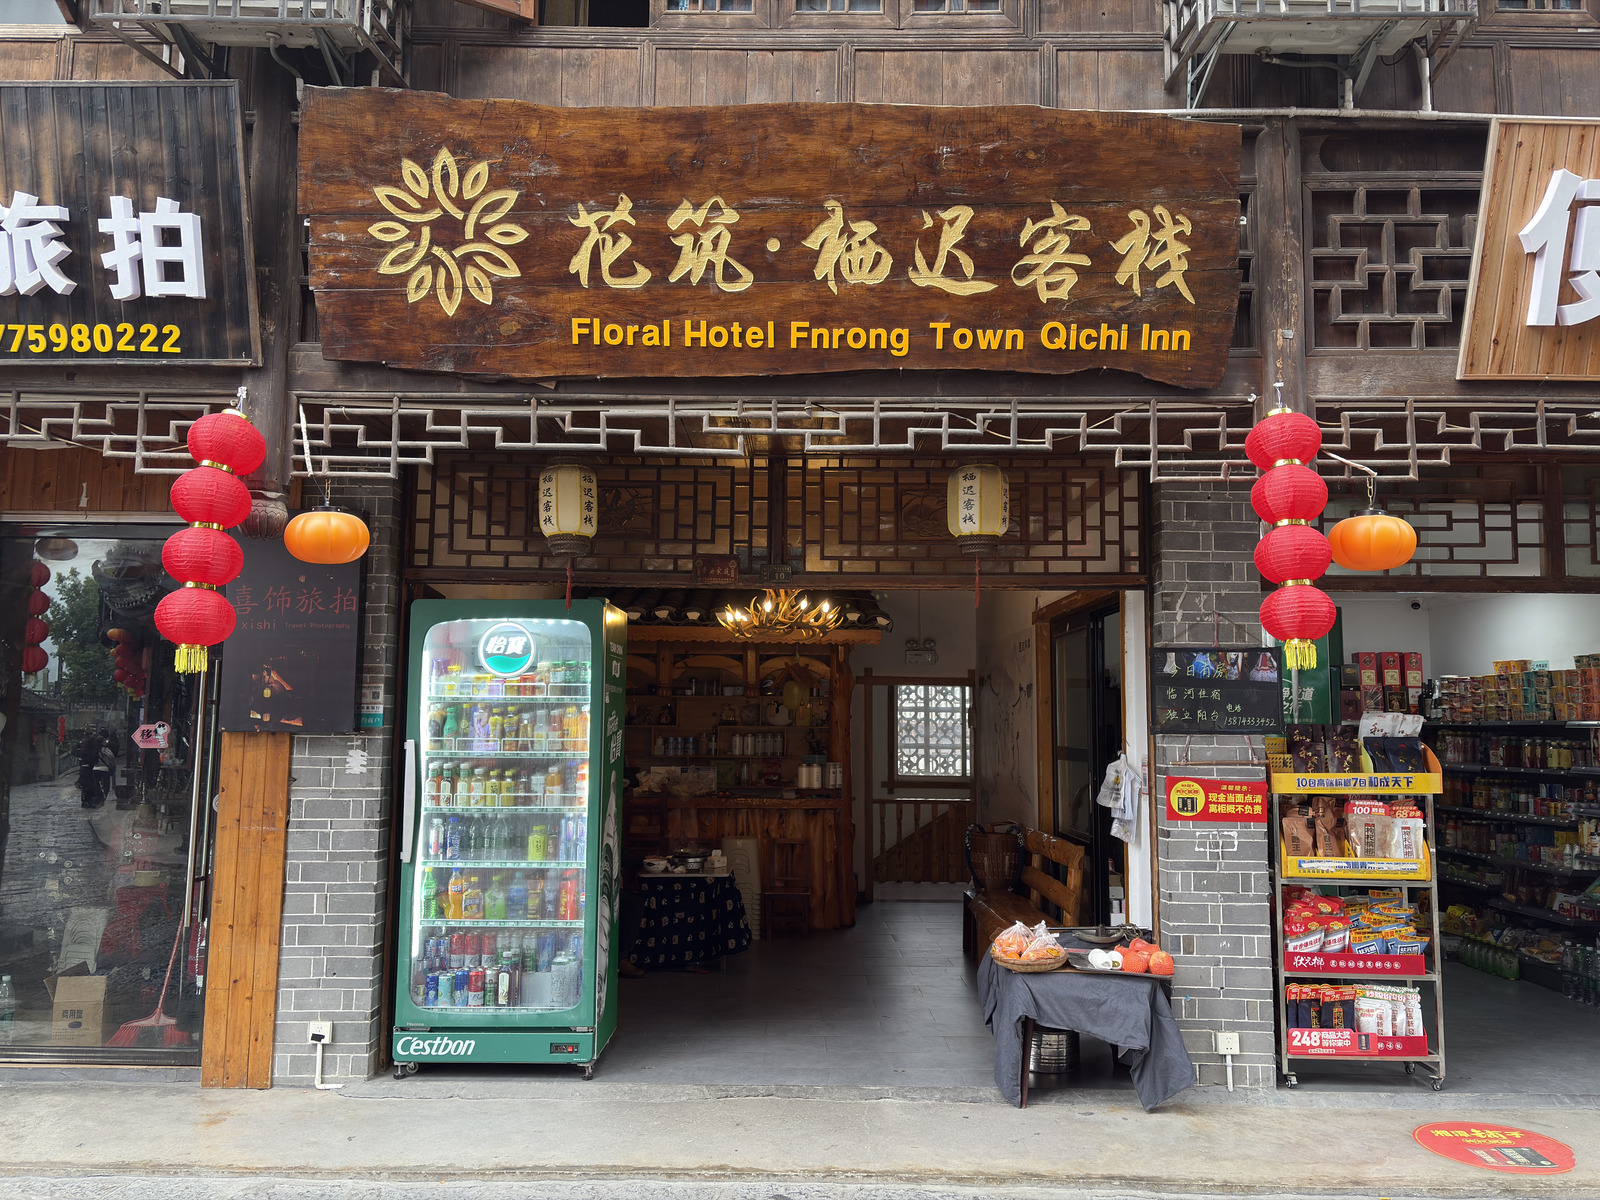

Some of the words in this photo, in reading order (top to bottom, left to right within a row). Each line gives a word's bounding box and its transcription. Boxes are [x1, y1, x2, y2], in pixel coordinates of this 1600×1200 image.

[0, 322, 182, 353] 75980222
[571, 317, 670, 347] Floral
[684, 319, 775, 349] Hotel
[790, 321, 910, 357] Fnrong
[929, 322, 1025, 350] Town
[1040, 321, 1129, 351] Qichi
[1141, 323, 1191, 351] Inn
[961, 472, 977, 525] 栖迟客栈
[232, 584, 358, 616] 喜饰旅拍
[1166, 687, 1221, 700] 临河住宿
[1166, 708, 1220, 723] 独立阳台
[1208, 793, 1263, 804] 现金当面点清
[1353, 807, 1370, 815] 100
